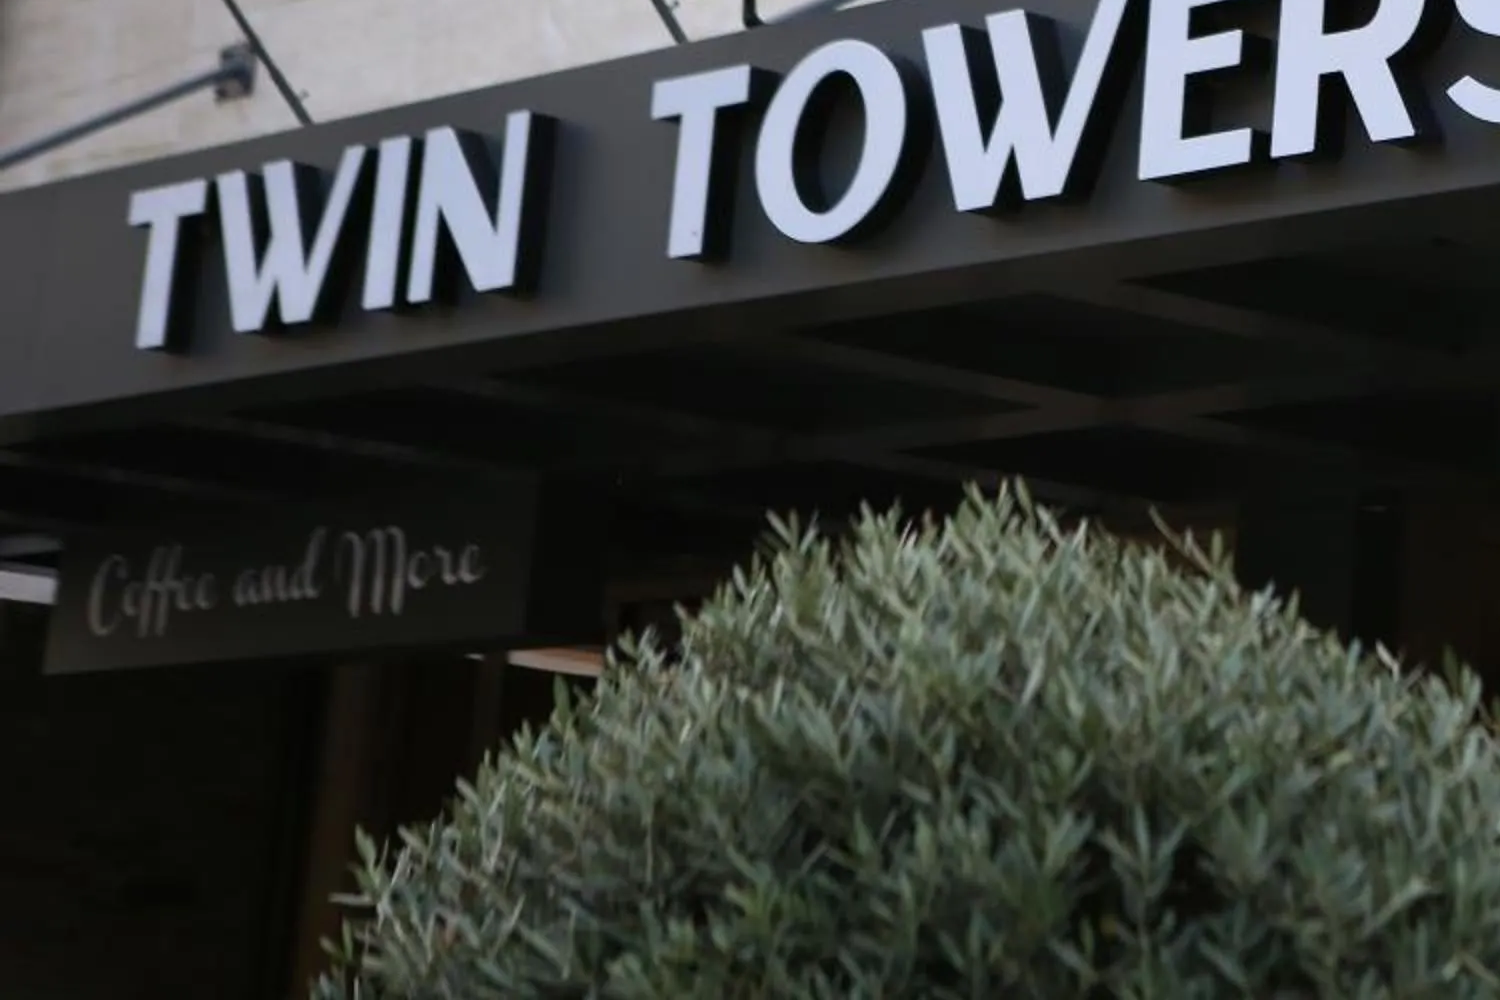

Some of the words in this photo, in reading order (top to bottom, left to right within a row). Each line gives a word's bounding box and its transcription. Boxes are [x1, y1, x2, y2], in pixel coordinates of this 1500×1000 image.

[128, 110, 535, 351] TWIN
[87, 543, 215, 637] Coffee
[232, 526, 327, 607] and
[335, 525, 487, 618] More
